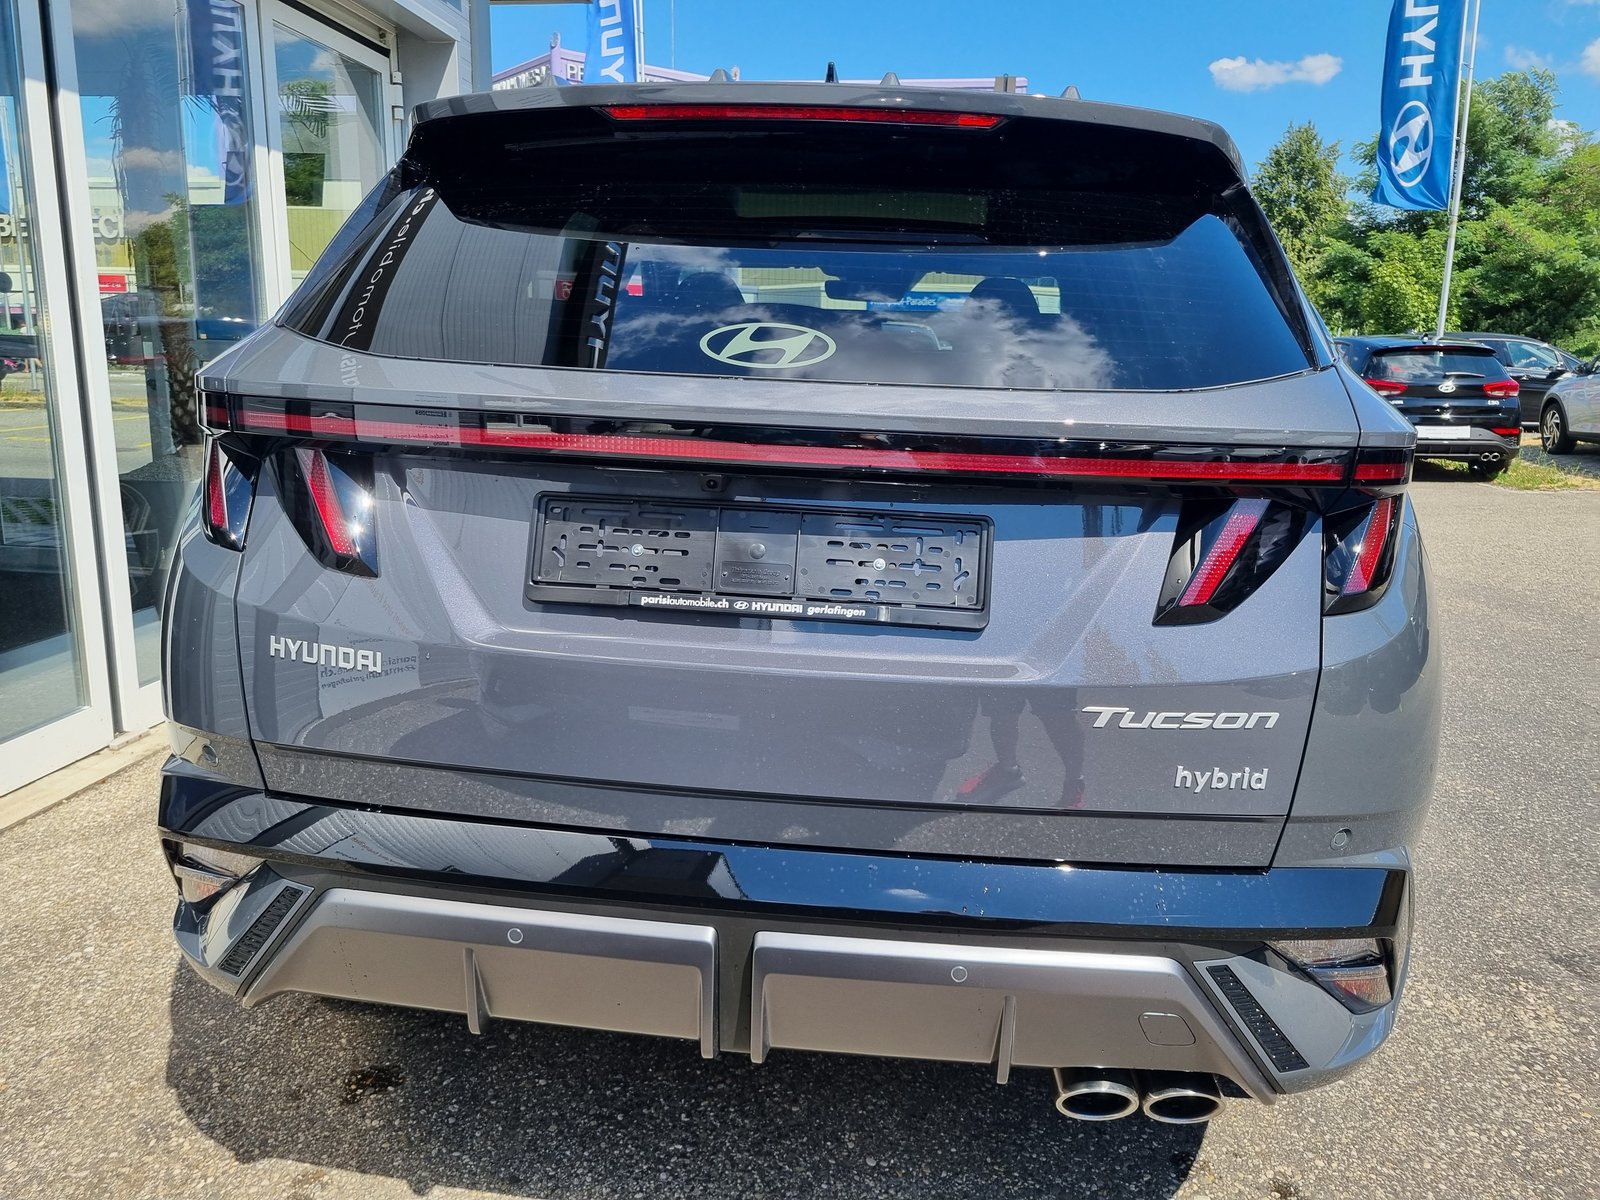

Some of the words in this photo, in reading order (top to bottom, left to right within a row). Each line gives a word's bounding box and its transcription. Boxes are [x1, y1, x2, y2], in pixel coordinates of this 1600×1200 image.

[641, 595, 729, 609] parisiautomobile.ch
[751, 601, 803, 613] HYUNDAI
[806, 605, 866, 617] gerlafingen
[269, 635, 383, 674] HYUNDAI
[1174, 765, 1269, 793] hybrid
